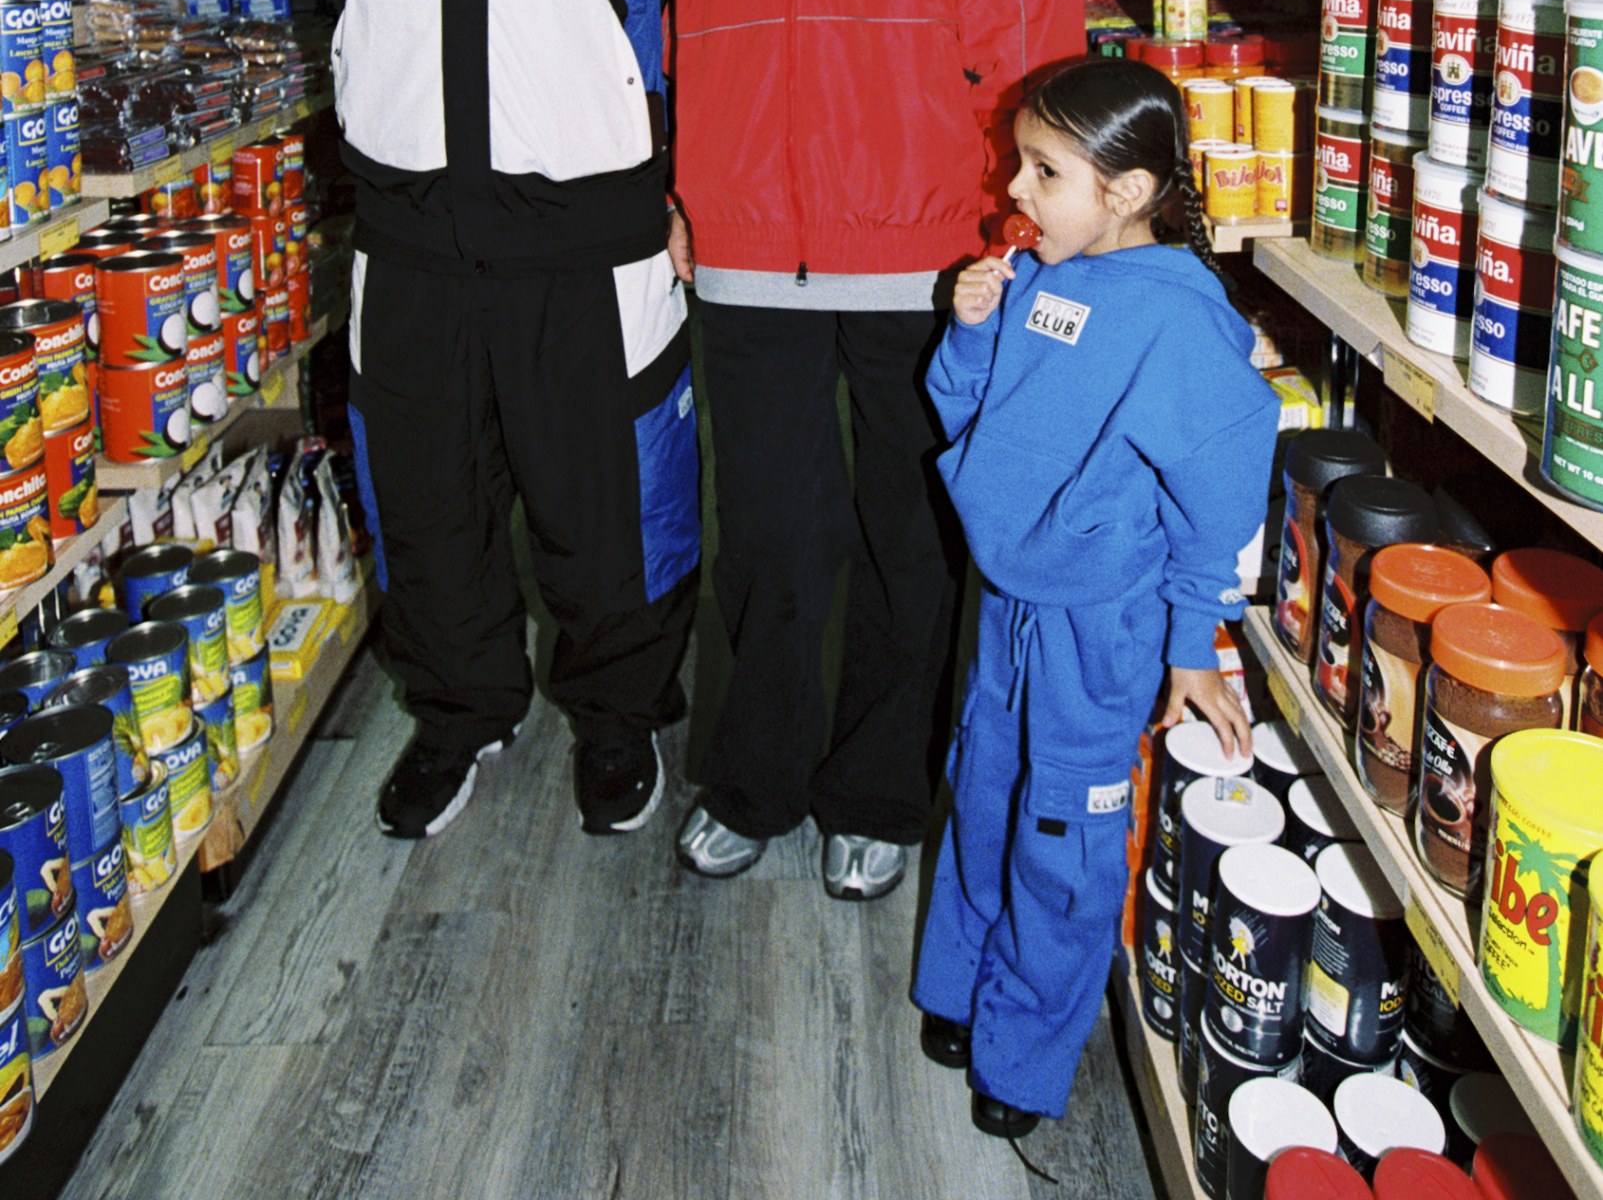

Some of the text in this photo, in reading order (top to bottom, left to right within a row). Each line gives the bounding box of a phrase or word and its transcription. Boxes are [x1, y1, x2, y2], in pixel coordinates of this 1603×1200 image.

[1032, 309, 1076, 336] CLUB
[1213, 946, 1287, 1001] ORTON
[1247, 995, 1284, 1014] SALT
